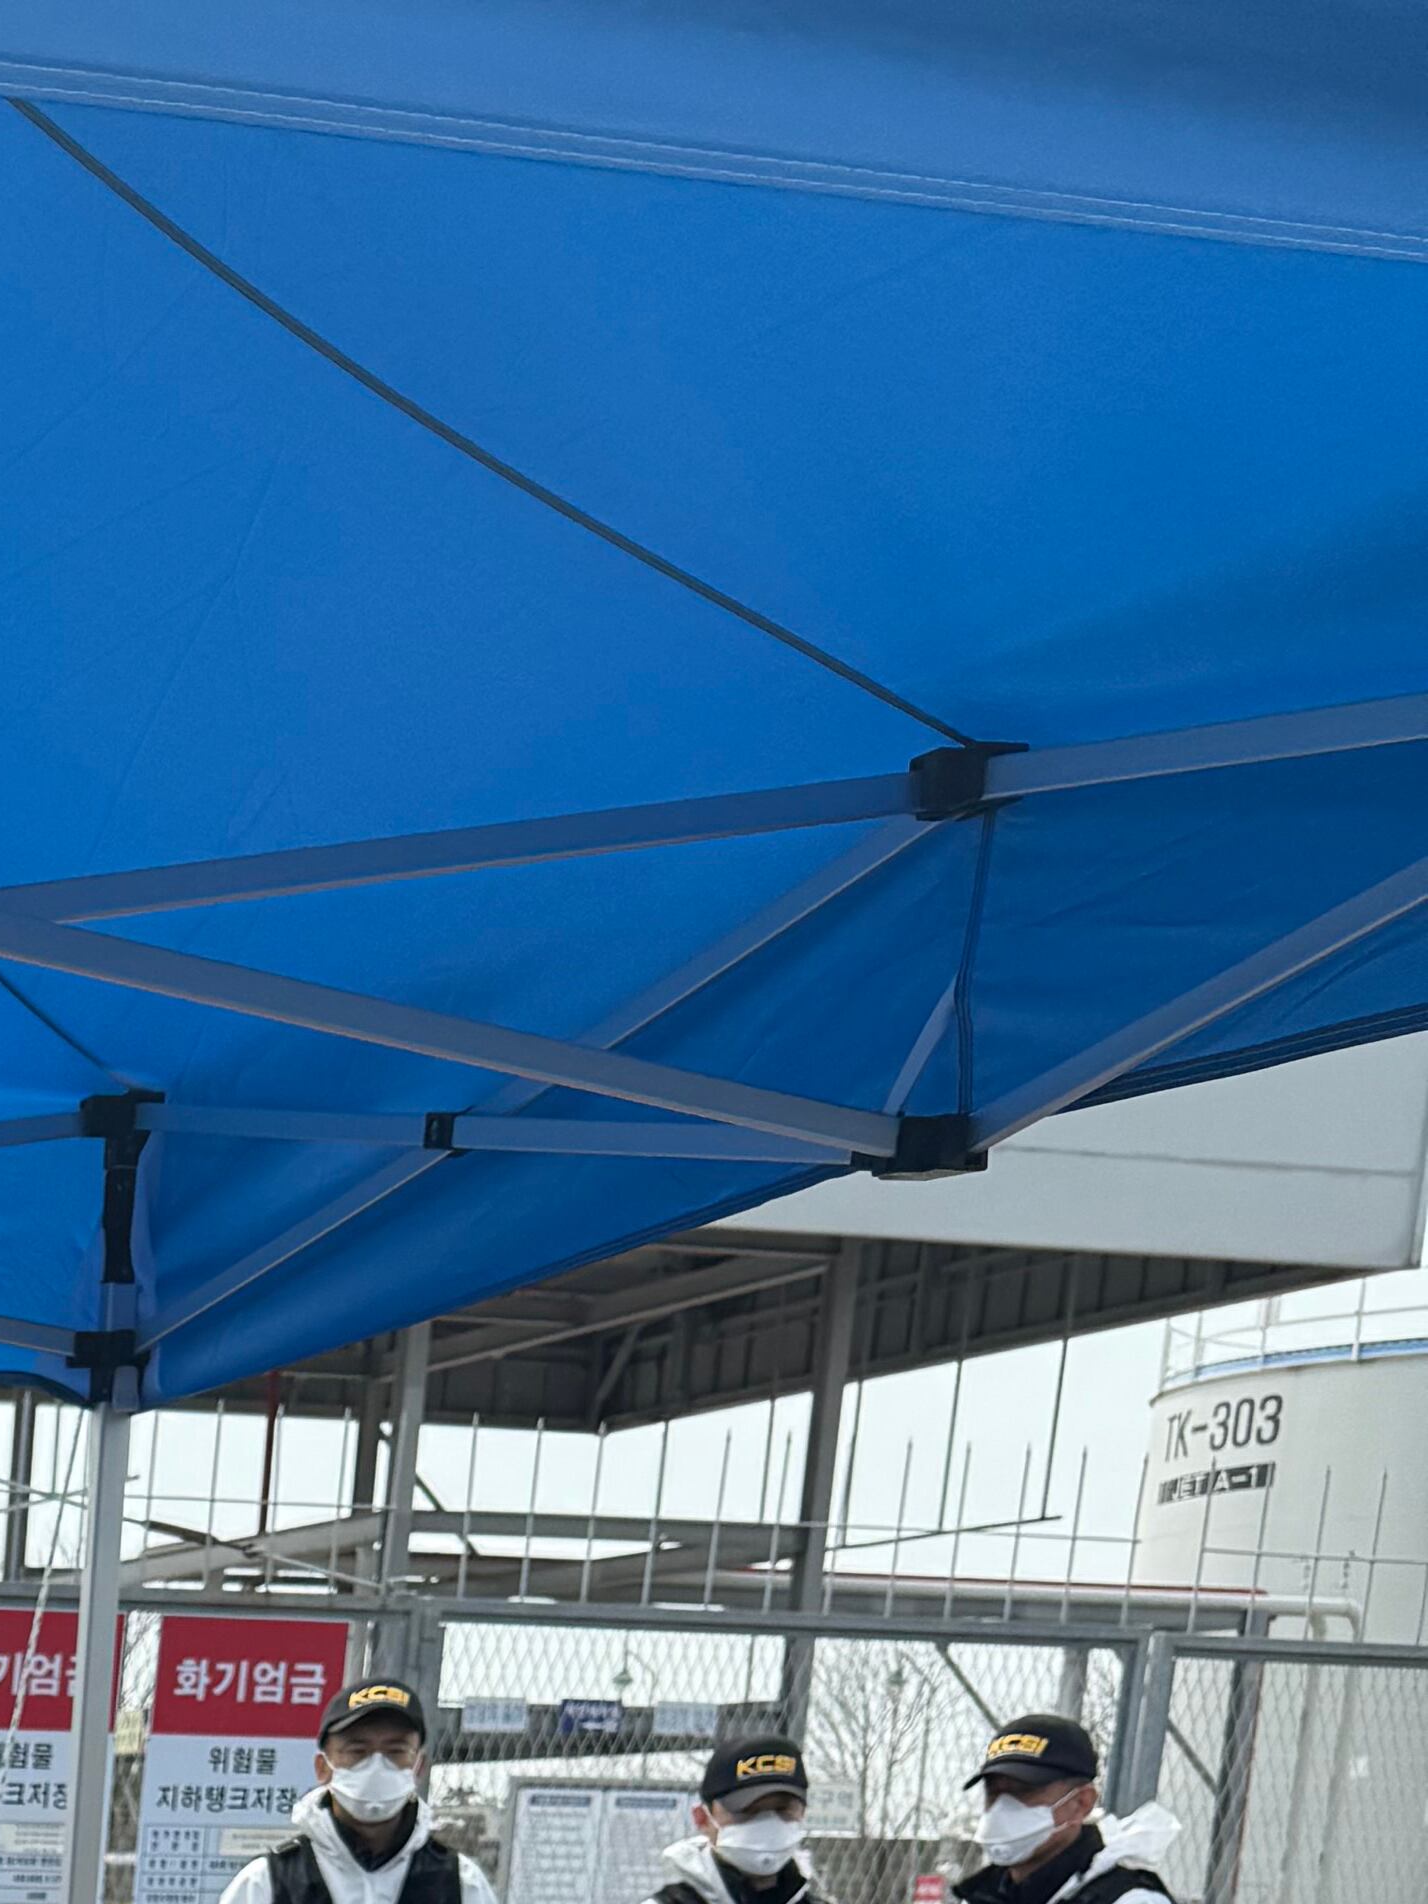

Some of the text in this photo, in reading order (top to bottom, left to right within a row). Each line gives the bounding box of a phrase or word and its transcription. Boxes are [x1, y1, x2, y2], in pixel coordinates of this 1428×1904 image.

[1165, 1394, 1283, 1463] TK-303
[1172, 1465, 1259, 1500] JET A-1
[174, 1656, 328, 1706] 화기엄금
[208, 1746, 279, 1777] 위험물
[735, 1754, 798, 1778] KCSI
